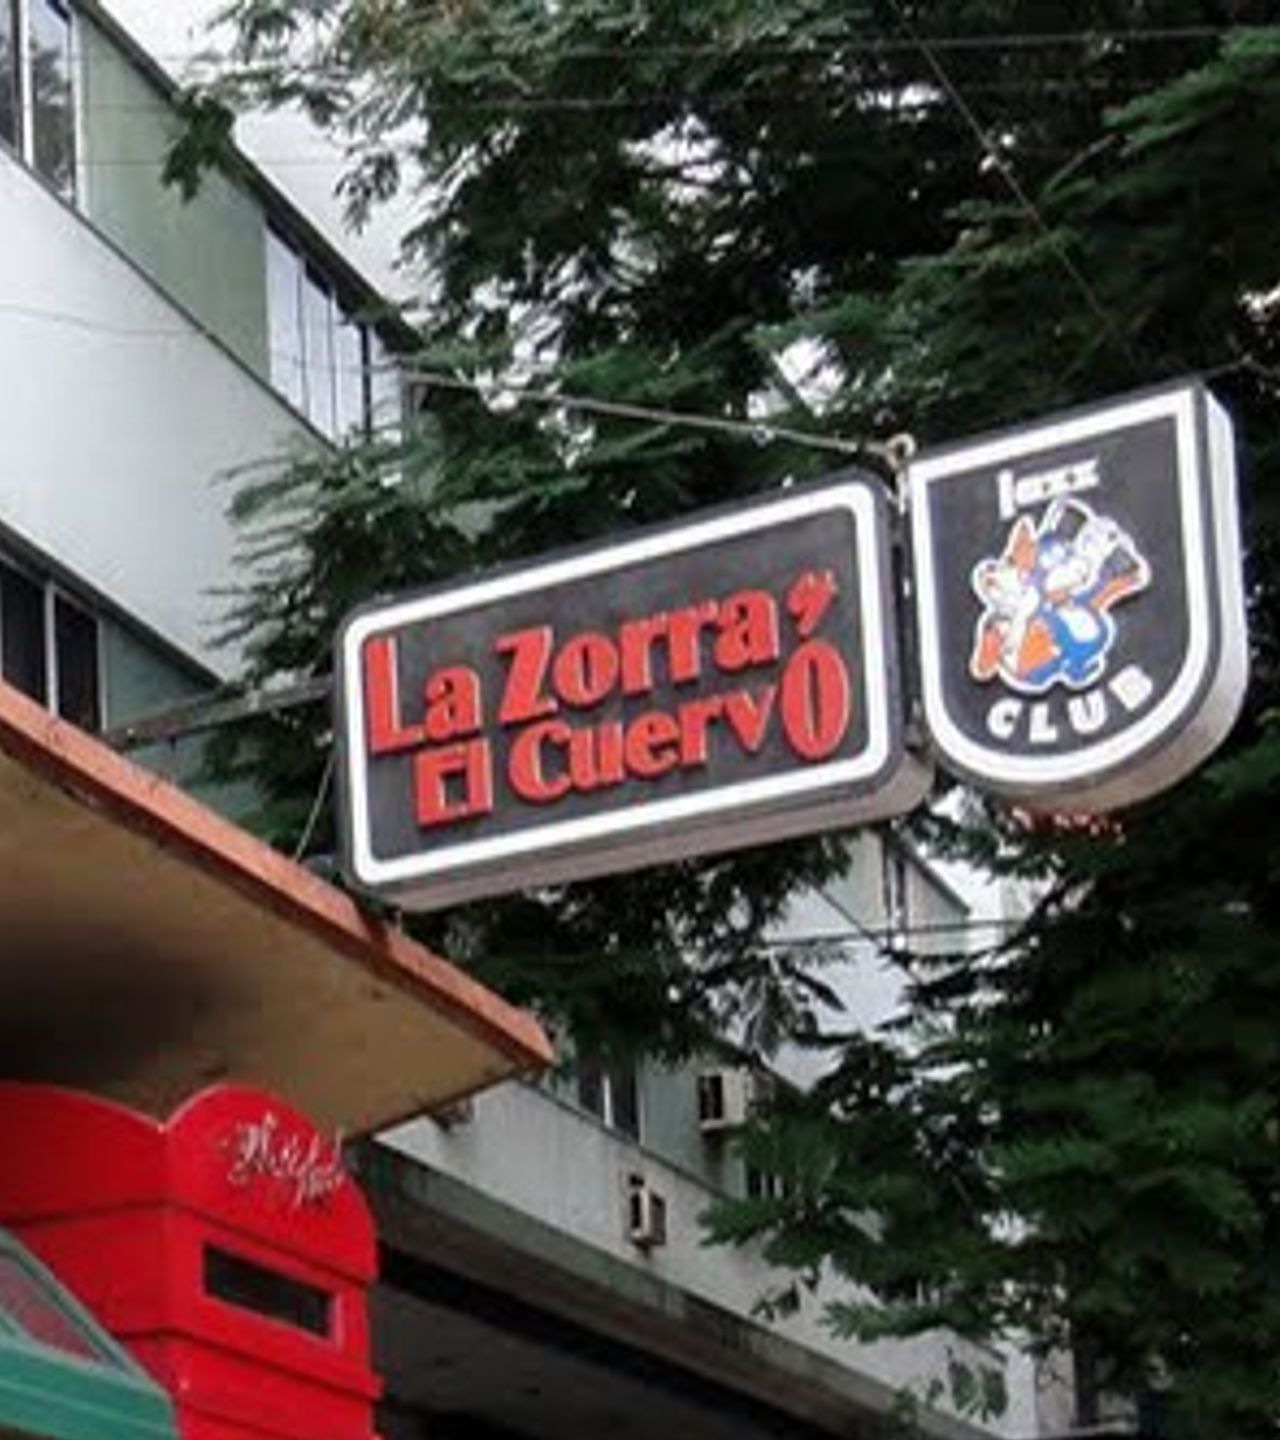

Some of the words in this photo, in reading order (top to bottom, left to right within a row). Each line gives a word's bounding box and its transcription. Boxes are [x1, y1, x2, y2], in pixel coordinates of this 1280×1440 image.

[362, 636, 481, 754] La
[495, 588, 778, 724] Zorra
[986, 664, 1154, 743] CLUB
[413, 738, 492, 827] El
